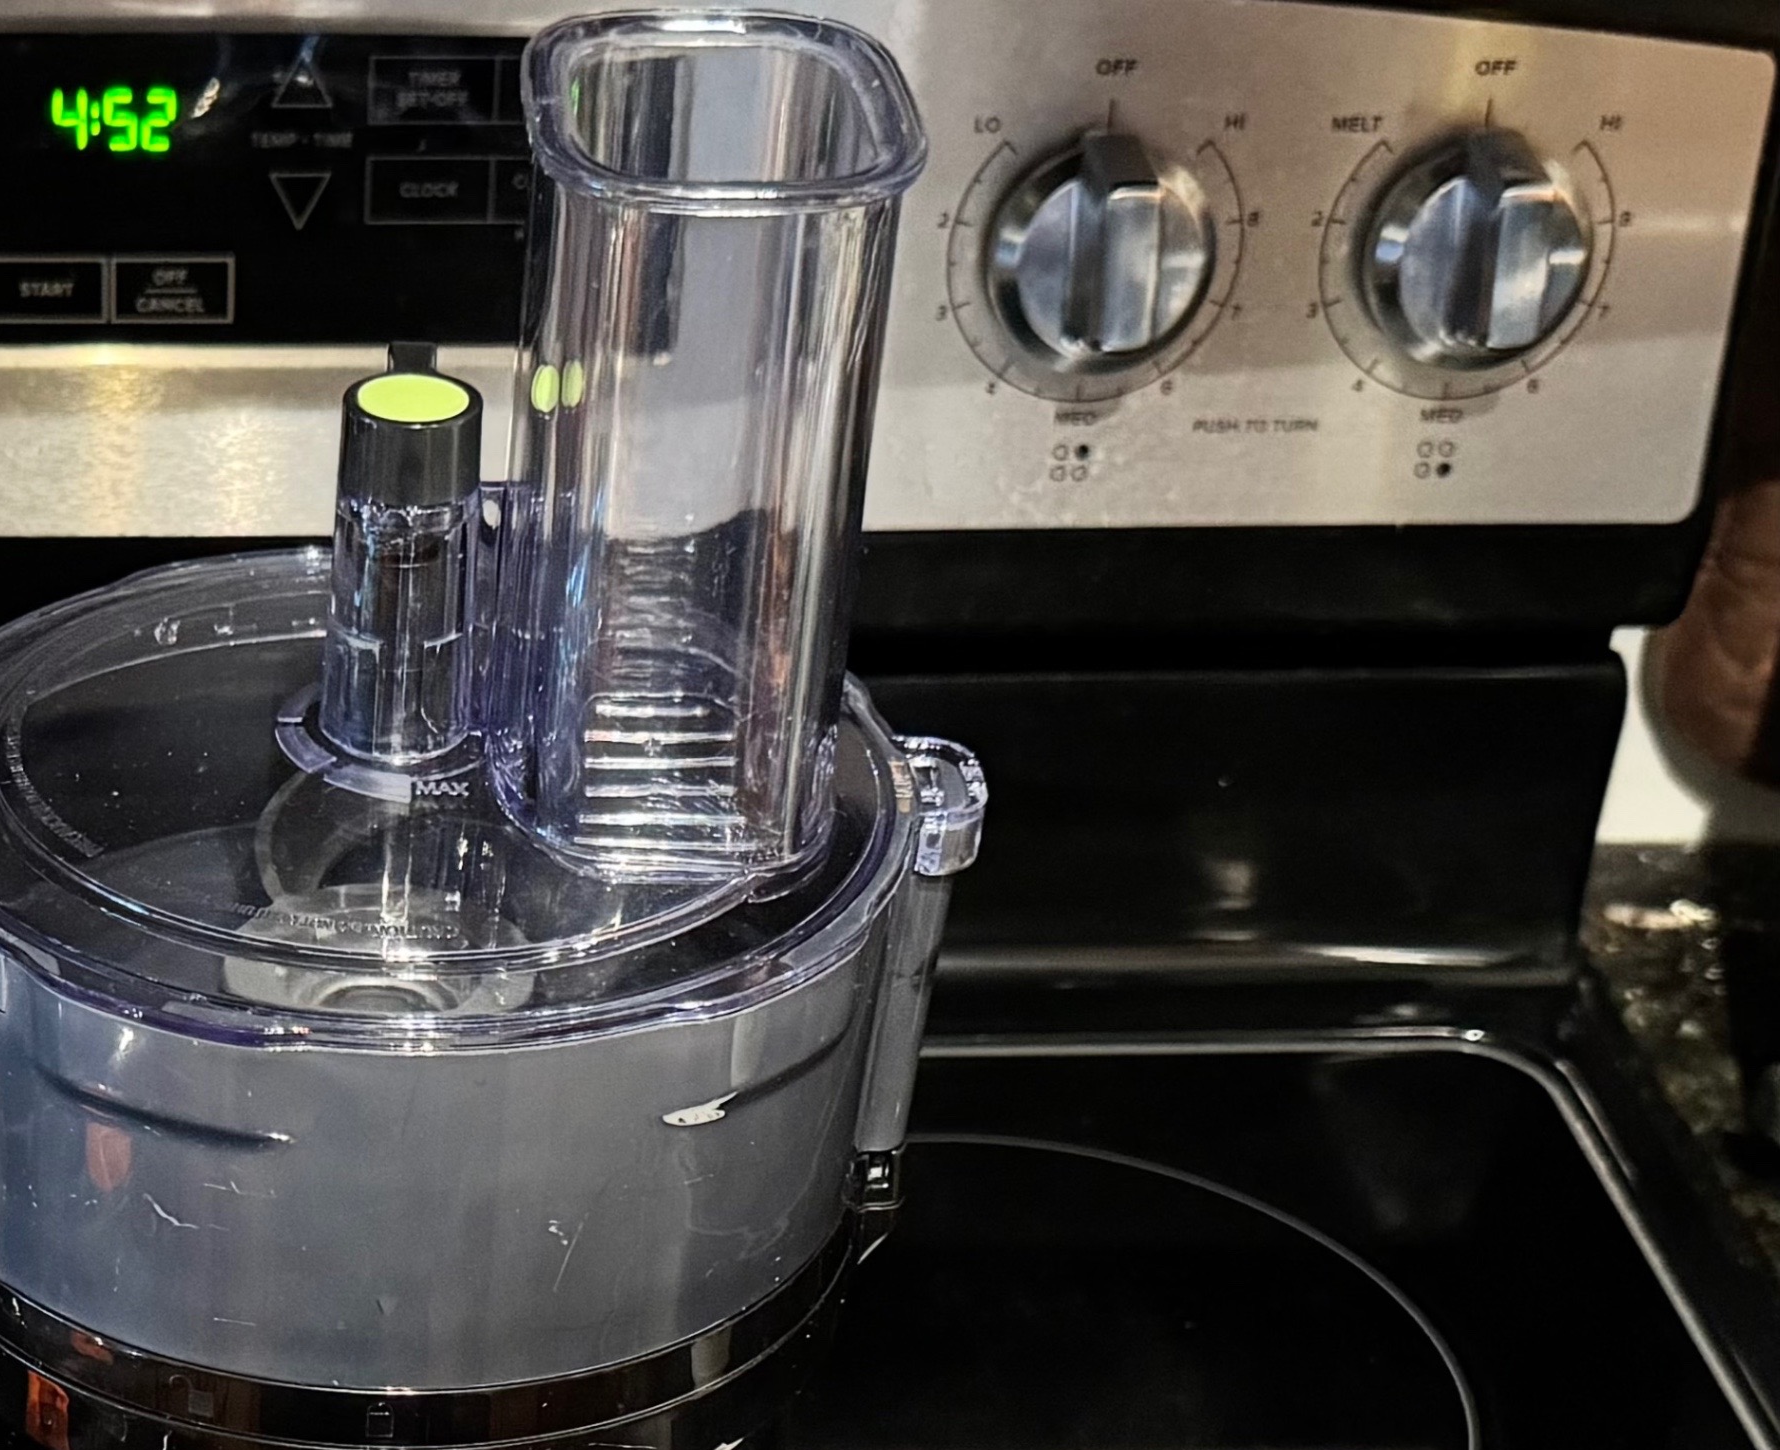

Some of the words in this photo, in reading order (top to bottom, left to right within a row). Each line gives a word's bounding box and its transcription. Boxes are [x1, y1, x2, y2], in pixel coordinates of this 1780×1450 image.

[1096, 59, 1137, 76] OFF
[1475, 60, 1517, 76] OFF
[51, 86, 177, 152] 4:52
[974, 116, 1001, 133] LO
[1224, 113, 1245, 130] HI
[1331, 116, 1382, 133] MELT
[1600, 114, 1623, 131] HI
[937, 213, 949, 229] 2
[20, 282, 74, 297] START
[136, 297, 204, 313] CANCEL
[1230, 304, 1241, 320] 7
[1307, 303, 1318, 319] 3
[936, 306, 947, 321] 3
[1193, 419, 1239, 433] PUSH
[1246, 419, 1267, 433] TO
[1274, 419, 1318, 433] TURN
[415, 781, 469, 797] MAX
